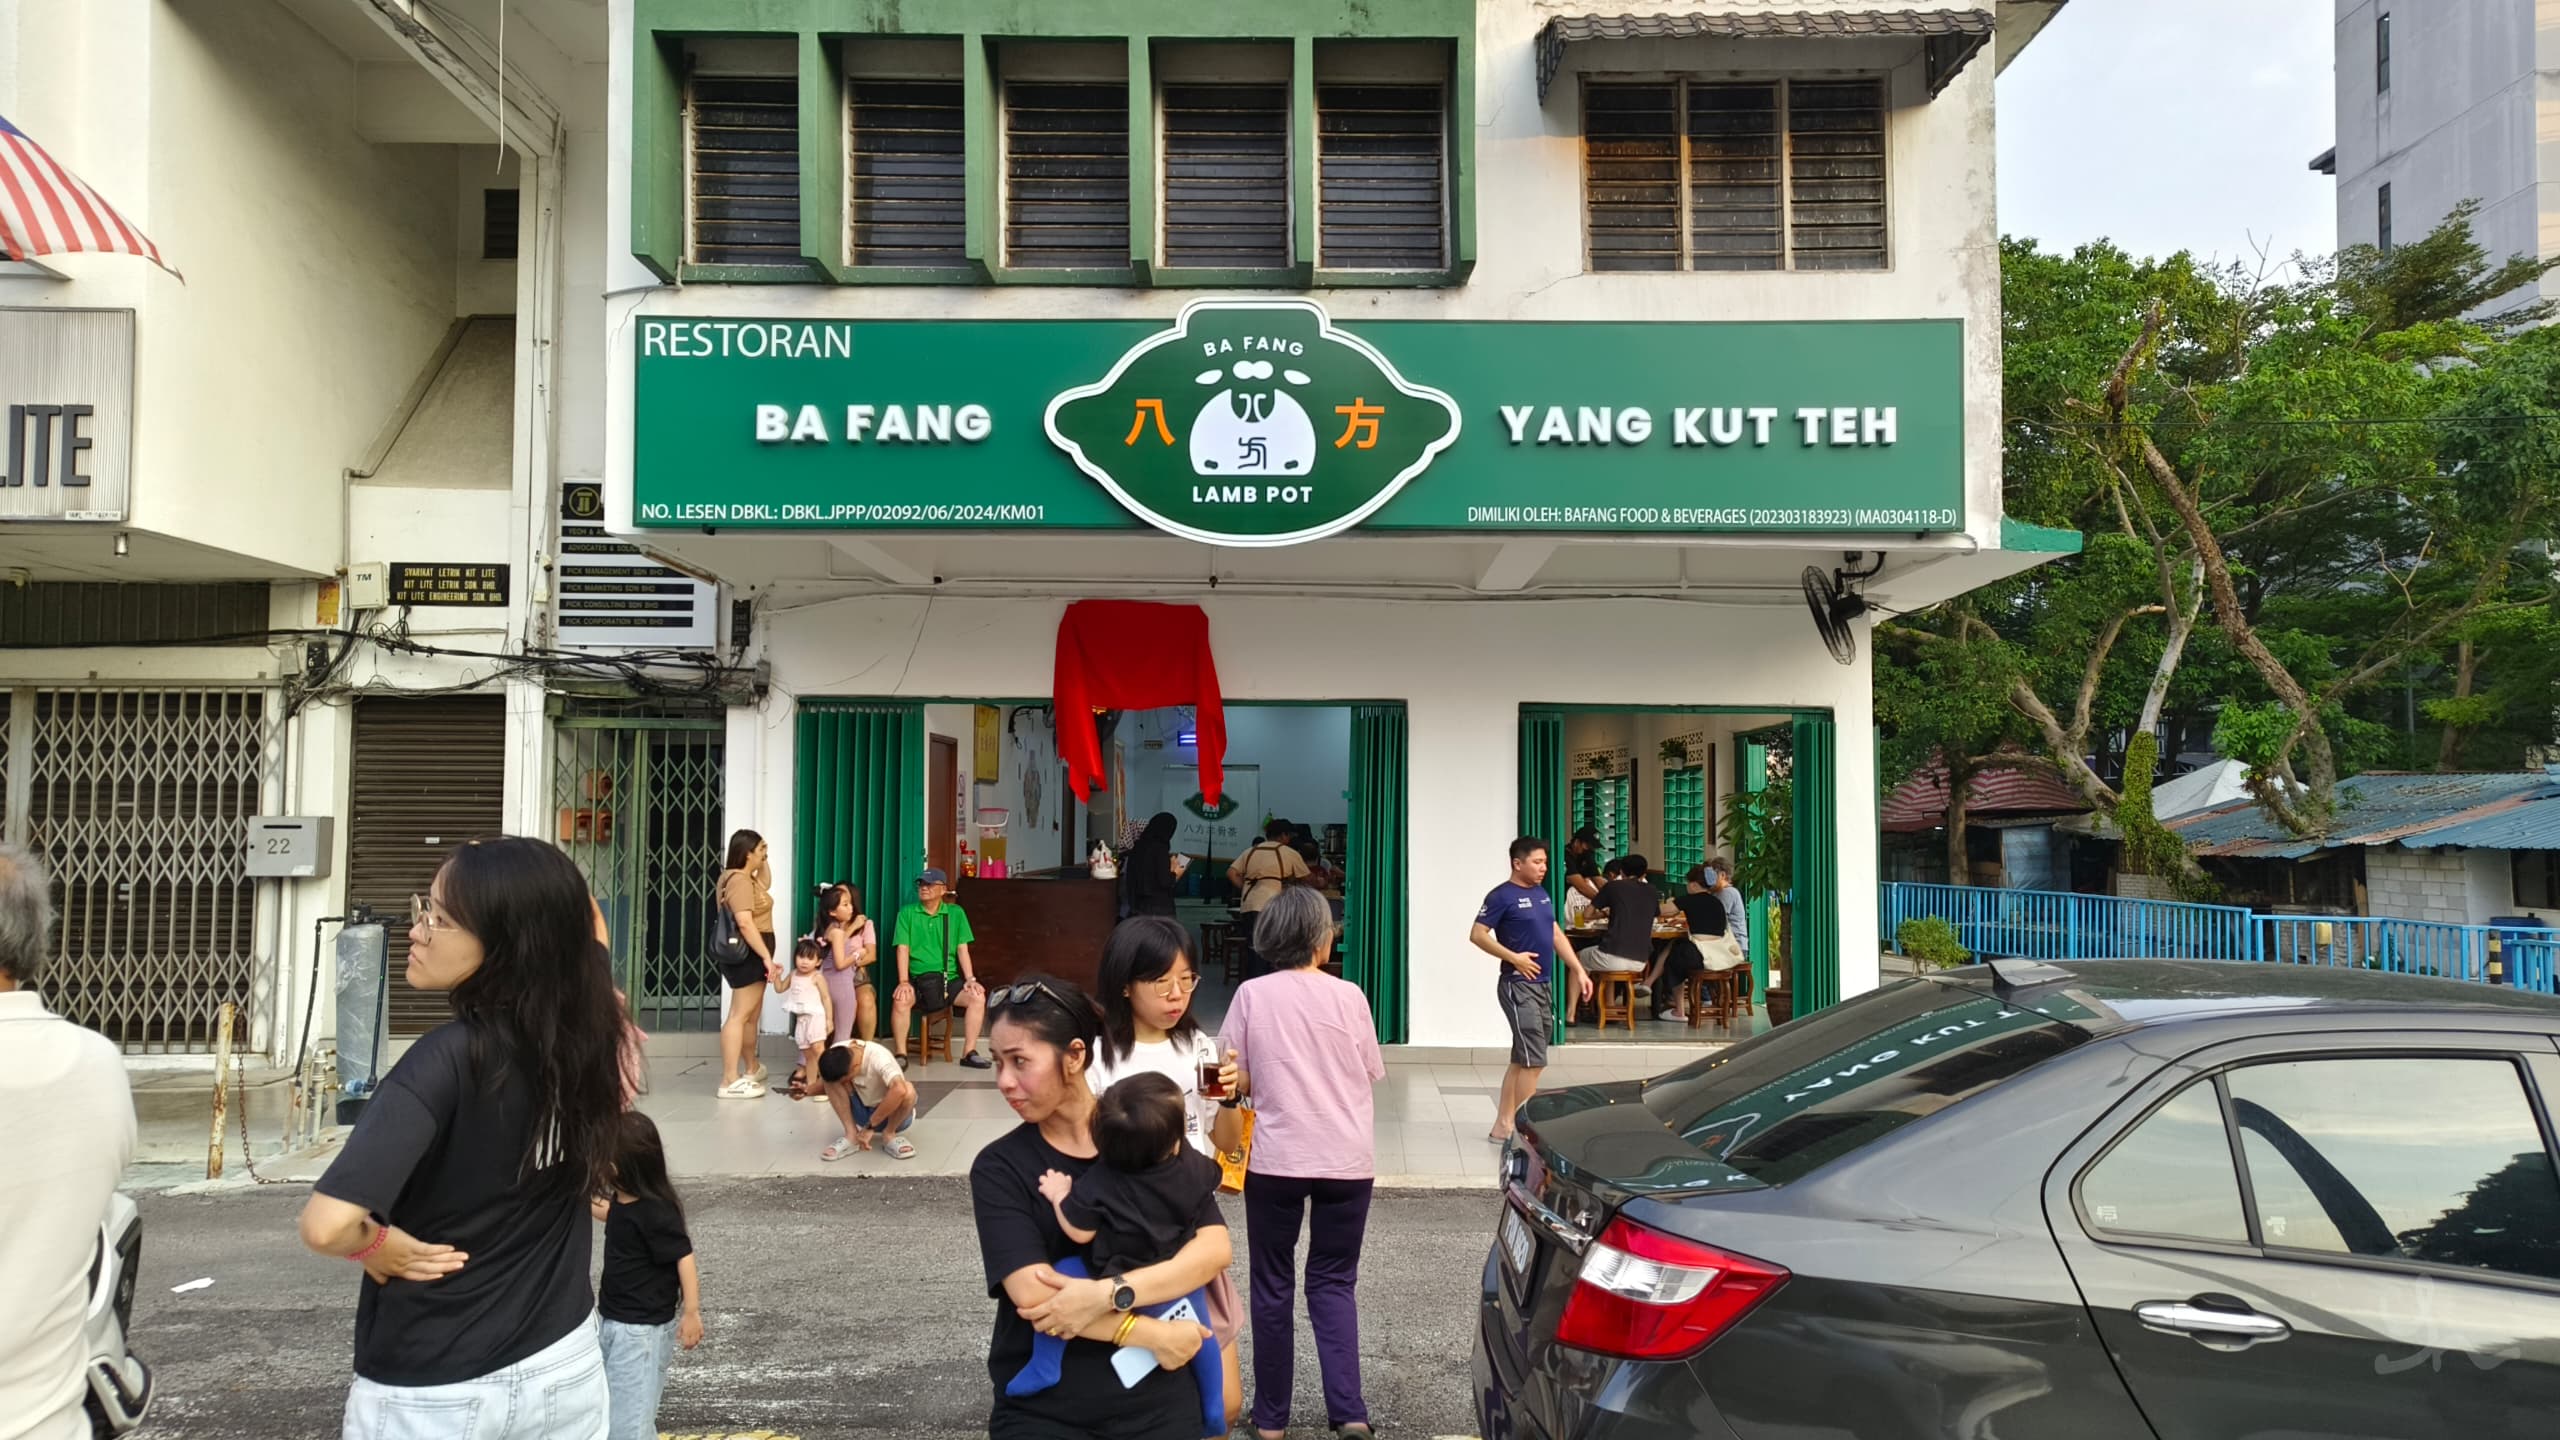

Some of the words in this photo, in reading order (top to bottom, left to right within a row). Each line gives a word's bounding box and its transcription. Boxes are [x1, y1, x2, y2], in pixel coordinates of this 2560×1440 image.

[643, 323, 852, 359] RESTORAN
[1203, 337, 1233, 357] BA
[1243, 335, 1305, 357] FANG
[755, 403, 829, 445] BA
[845, 403, 993, 445] FANG
[1124, 398, 1176, 447] 八
[1334, 397, 1386, 449] 方
[1499, 404, 1653, 446] YANG
[1672, 405, 1779, 446] KUT
[1795, 405, 1898, 447] TEH
[0, 403, 94, 487] ITE
[1192, 485, 1257, 504] LAMB
[1265, 485, 1313, 504] POT
[641, 503, 672, 520] NO.
[676, 503, 726, 520] LESEN
[731, 504, 778, 521] DBKL:
[781, 503, 1045, 522] DBKL.JPPP/02092/06/2024/KM01
[1467, 506, 1520, 523] DIMILIKI
[1523, 506, 1562, 523] OLEH:
[1564, 507, 1617, 523] BAFANG
[1620, 508, 1659, 524] FOOD
[1661, 508, 1671, 524] &
[1673, 508, 1747, 525] BEVERAGES
[1749, 508, 1853, 526] (202303183923)
[1855, 509, 1957, 527] (MA0304118-D)
[356, 573, 372, 582] TM
[404, 567, 434, 577] SYARIKAT
[438, 567, 461, 578] LETRIK
[465, 568, 477, 578] KIT
[481, 568, 497, 578] LITE
[584, 568, 631, 576] MANAGEMENT
[403, 579, 415, 589] KIT
[419, 579, 433, 590] LITE
[438, 580, 460, 590] LETRIK
[396, 591, 406, 601] KIT
[410, 591, 425, 601] LITE
[429, 591, 468, 601] ENGINEERING
[267, 838, 291, 854] 22
